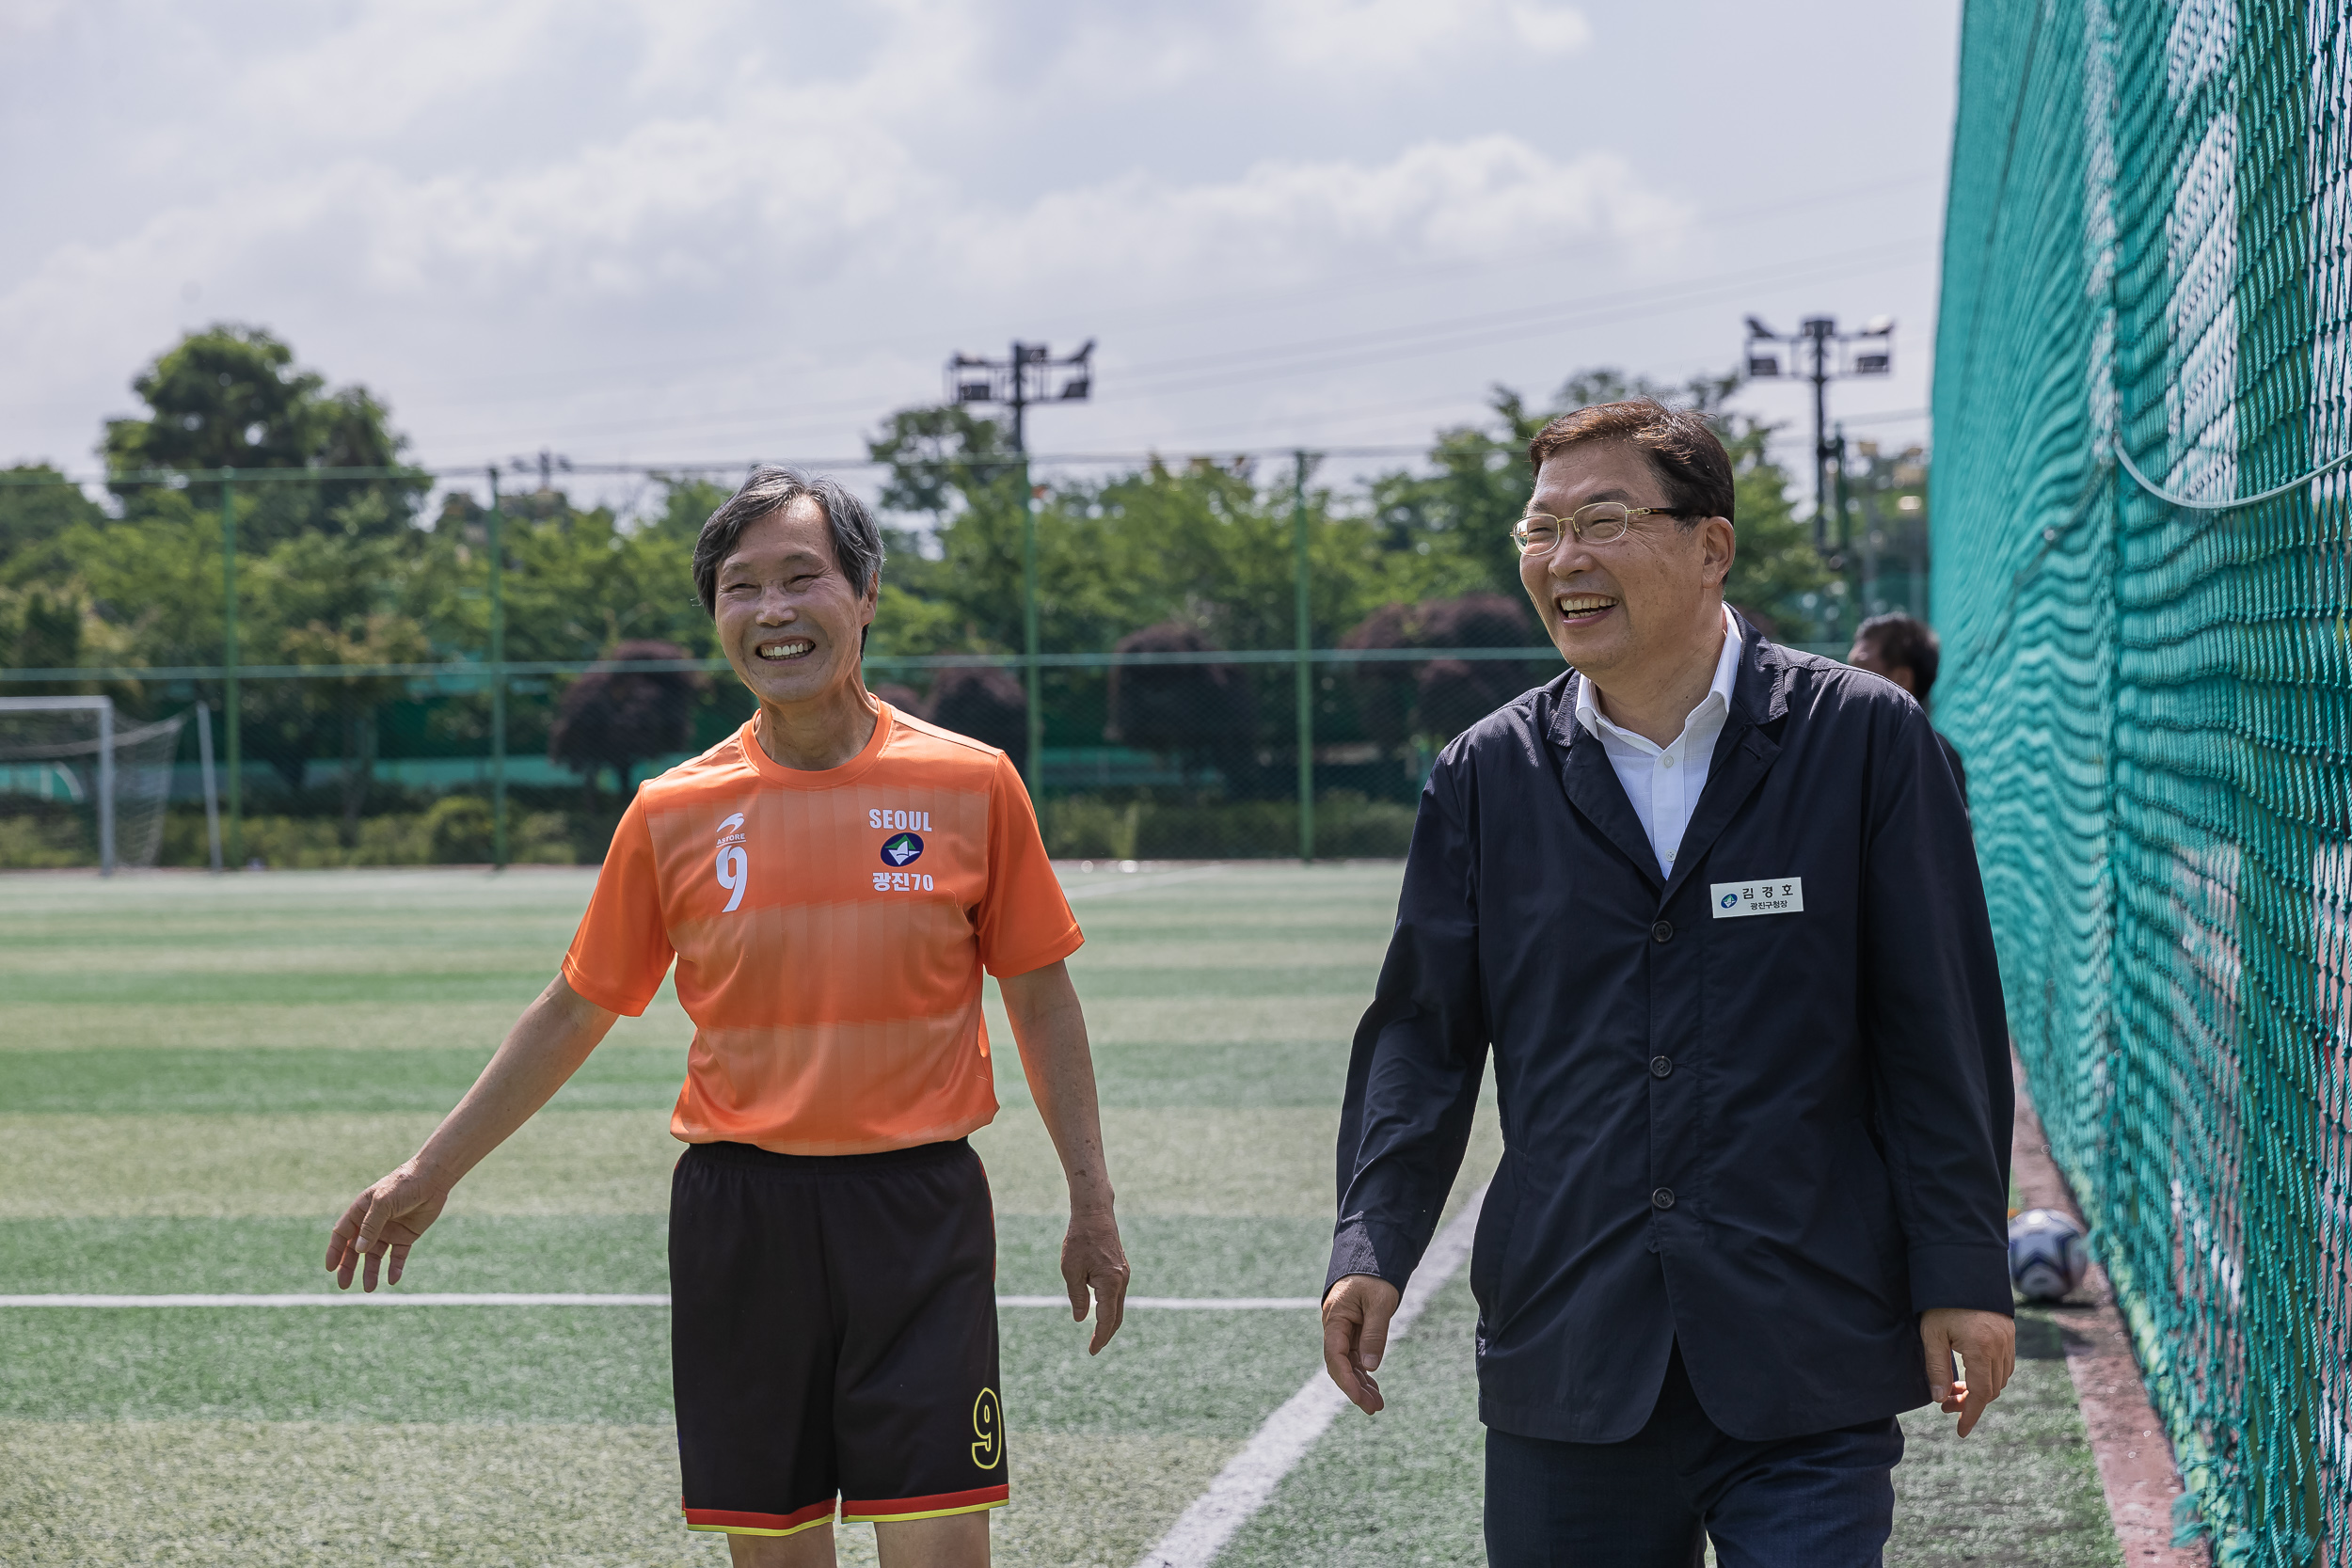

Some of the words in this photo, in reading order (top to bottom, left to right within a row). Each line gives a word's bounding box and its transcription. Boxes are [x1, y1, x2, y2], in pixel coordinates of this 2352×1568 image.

[868, 808, 932, 832] SEOUL
[717, 833, 745, 845] ASTORE
[715, 845, 748, 912] 9
[872, 872, 934, 892] 광진70
[1750, 900, 1788, 910] 광진구청장
[972, 1387, 1001, 1469] 9
